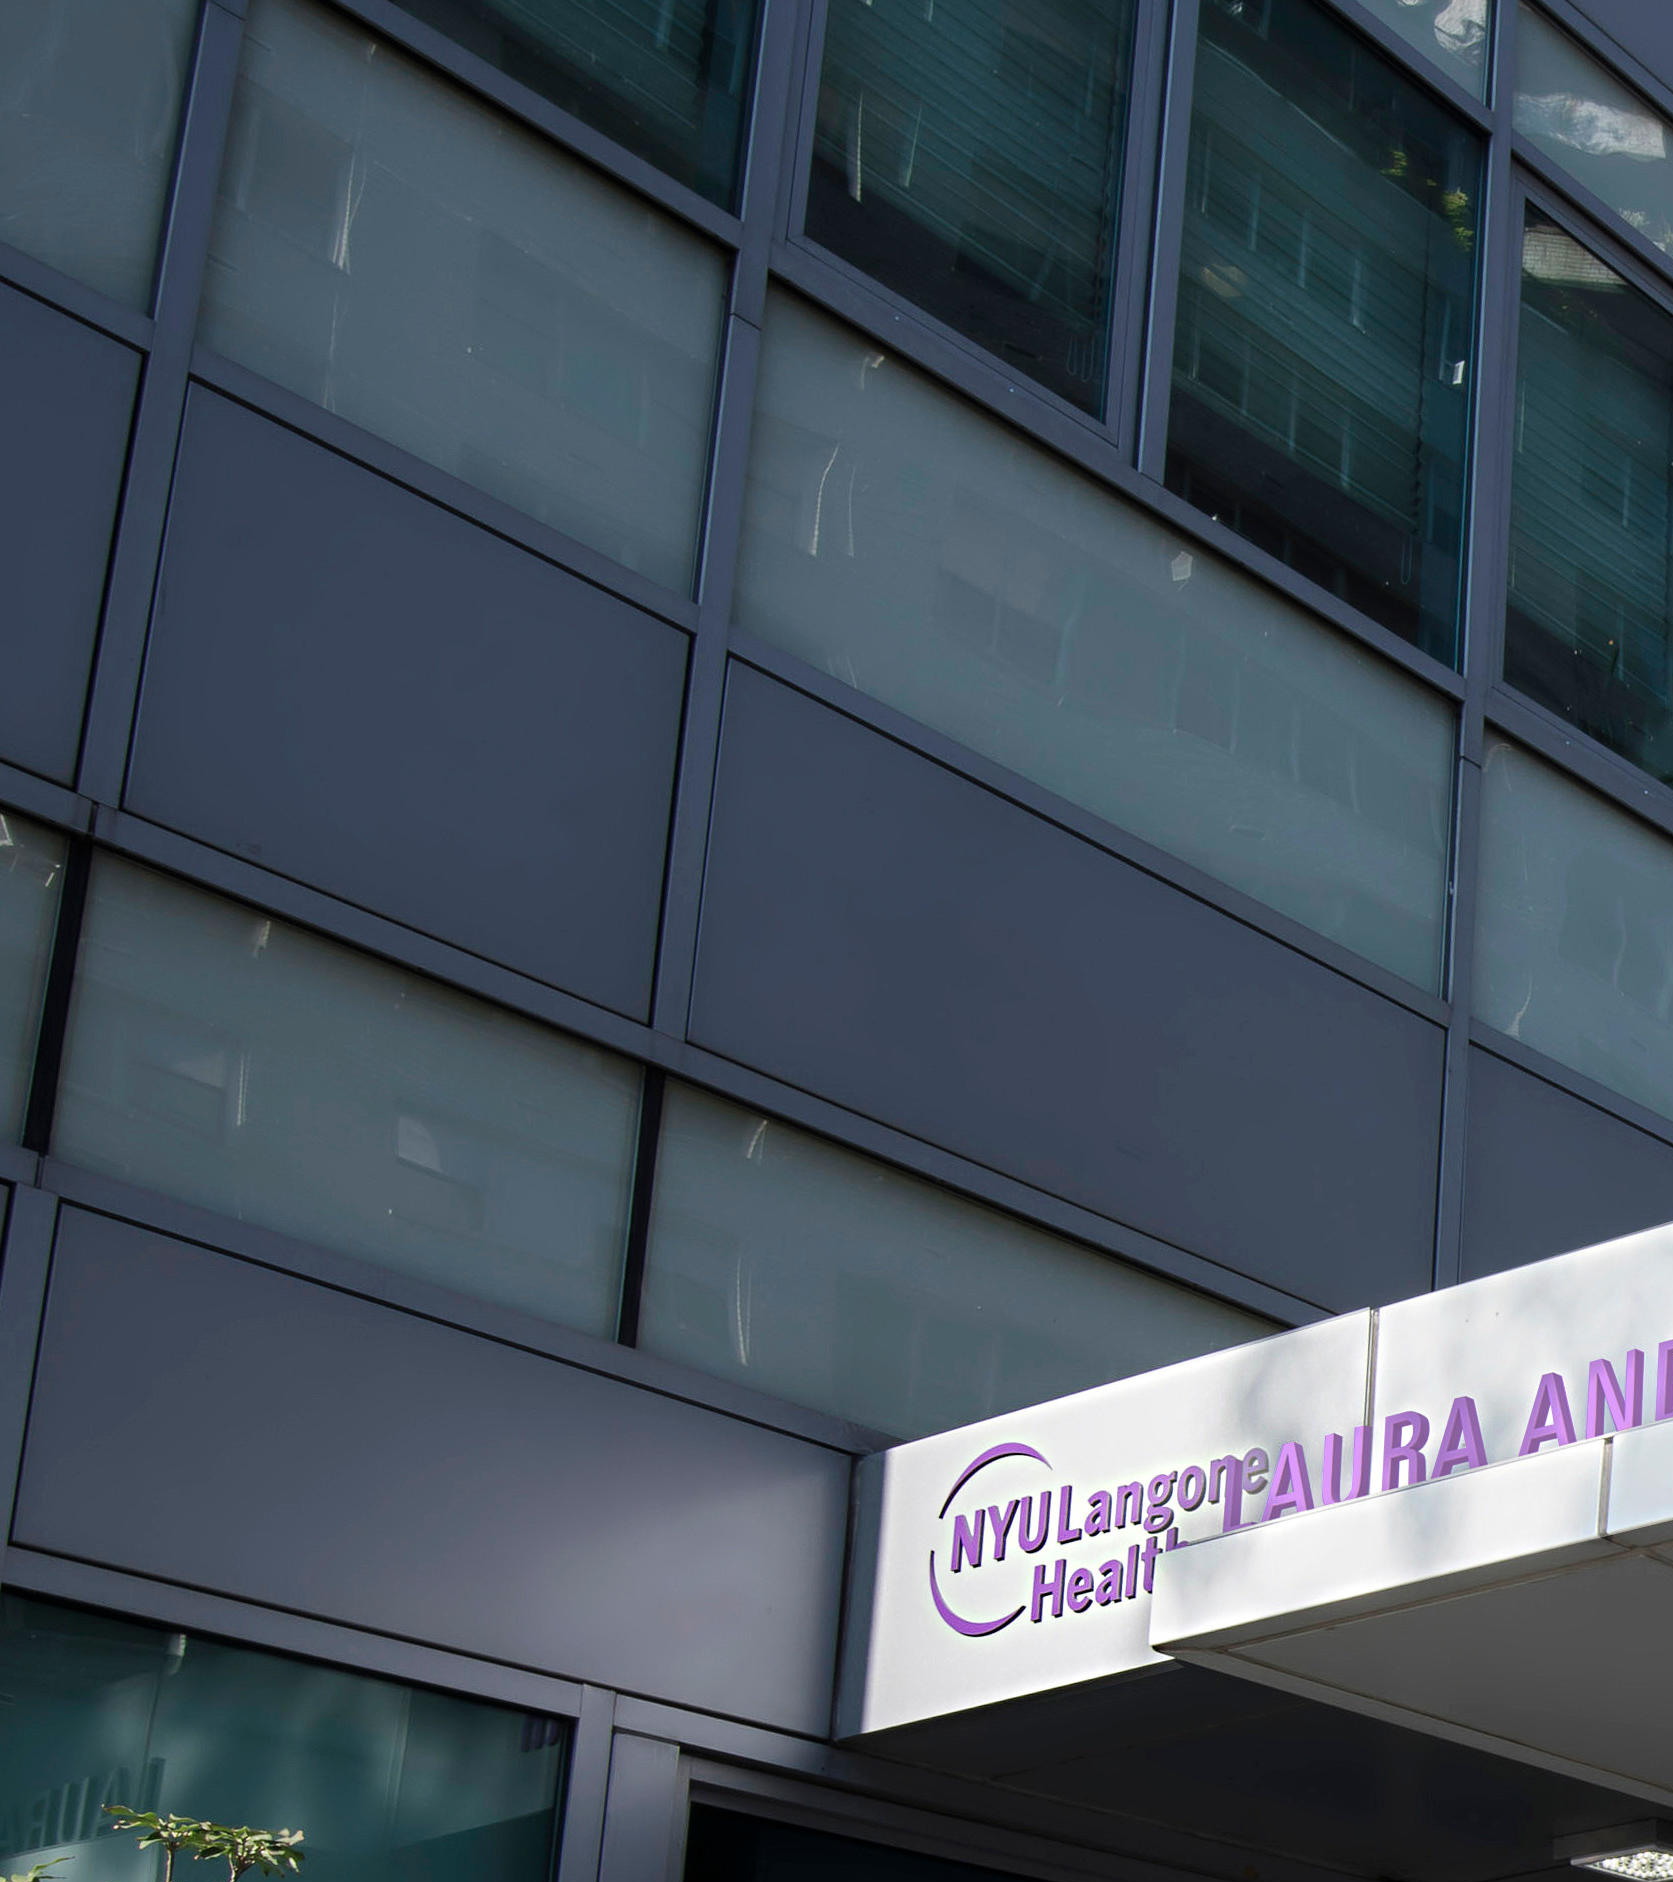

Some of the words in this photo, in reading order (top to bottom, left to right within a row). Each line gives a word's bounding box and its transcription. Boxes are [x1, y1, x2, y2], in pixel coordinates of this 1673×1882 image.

[950, 1484, 1048, 1574] NYU
[1056, 1446, 1270, 1546] Langone
[1226, 1395, 1489, 1534] LAURA
